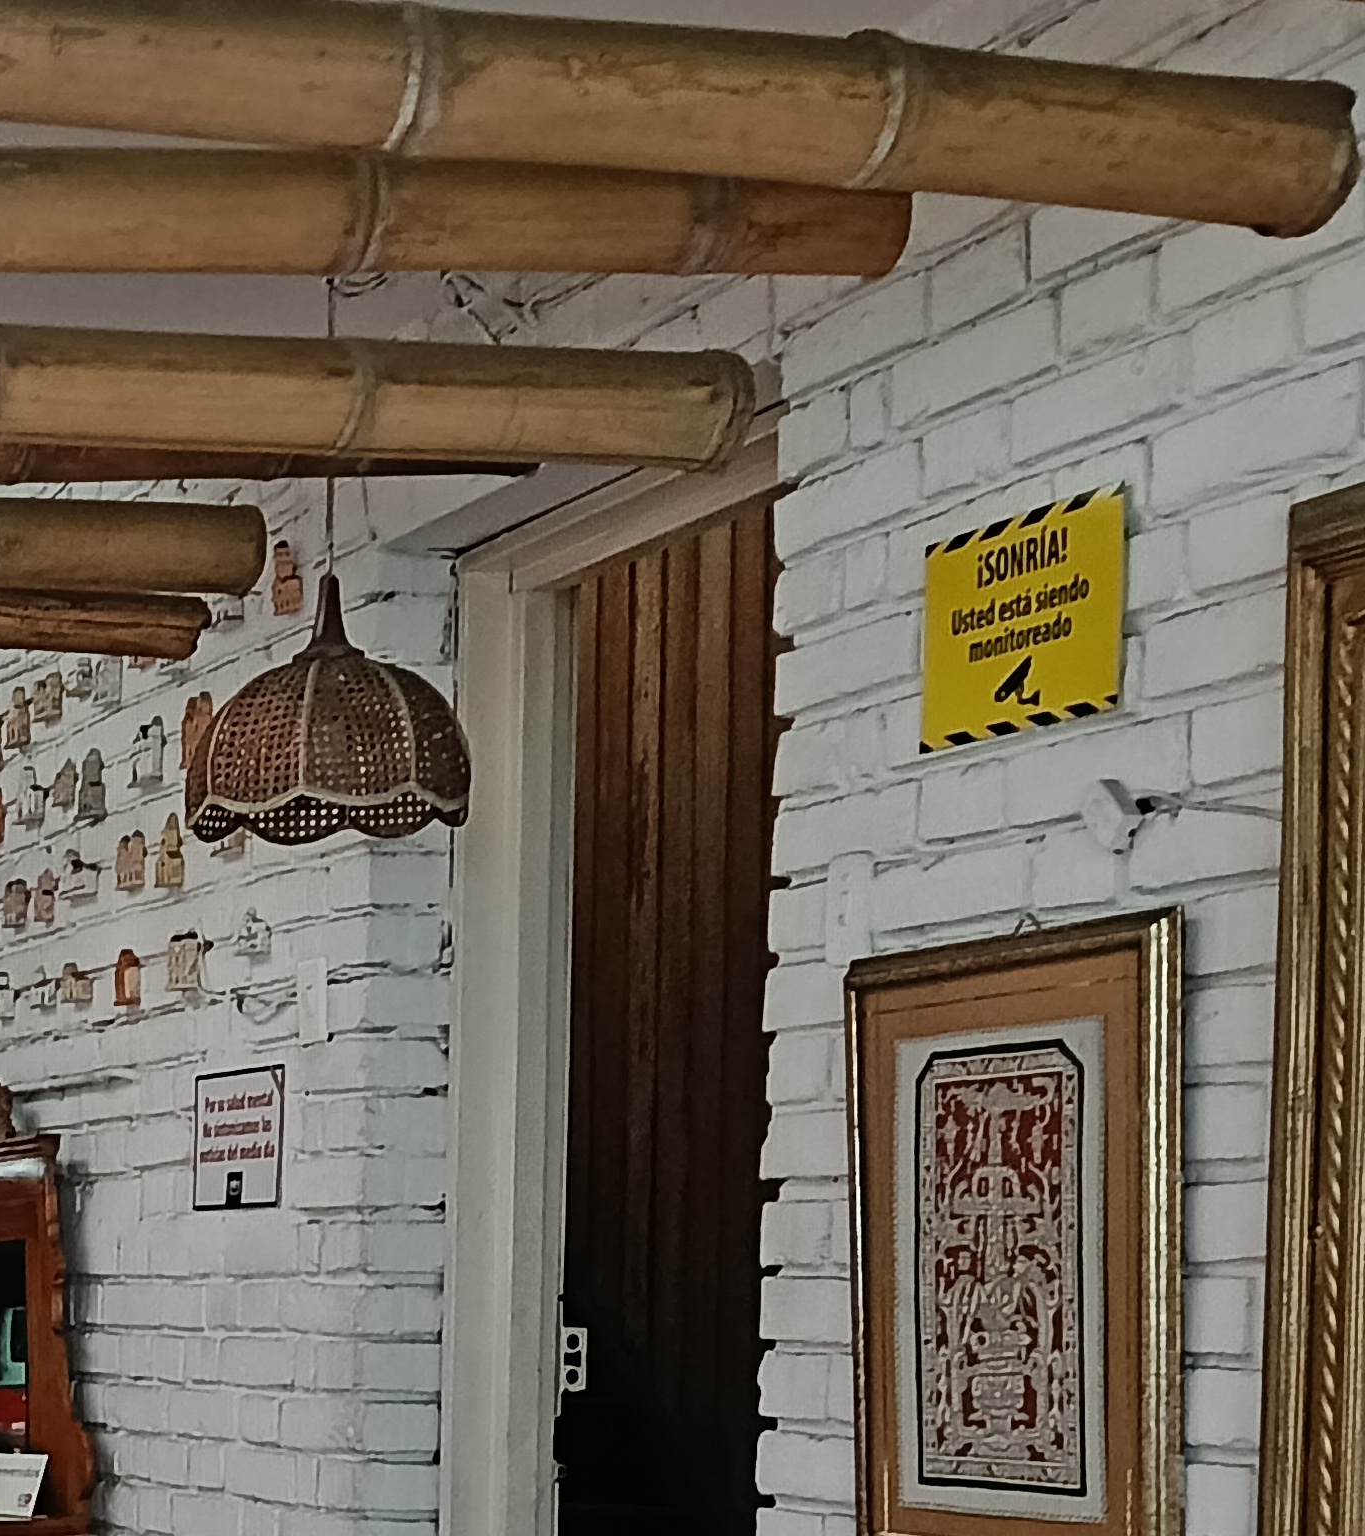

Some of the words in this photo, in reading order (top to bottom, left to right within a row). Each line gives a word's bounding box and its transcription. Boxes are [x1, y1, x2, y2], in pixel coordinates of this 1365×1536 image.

[976, 525, 1068, 589] ¡SONRÍA!
[951, 598, 996, 636] Usted
[998, 587, 1032, 621] está
[1035, 573, 1090, 612] siendo
[969, 610, 1073, 663] monitoreado
